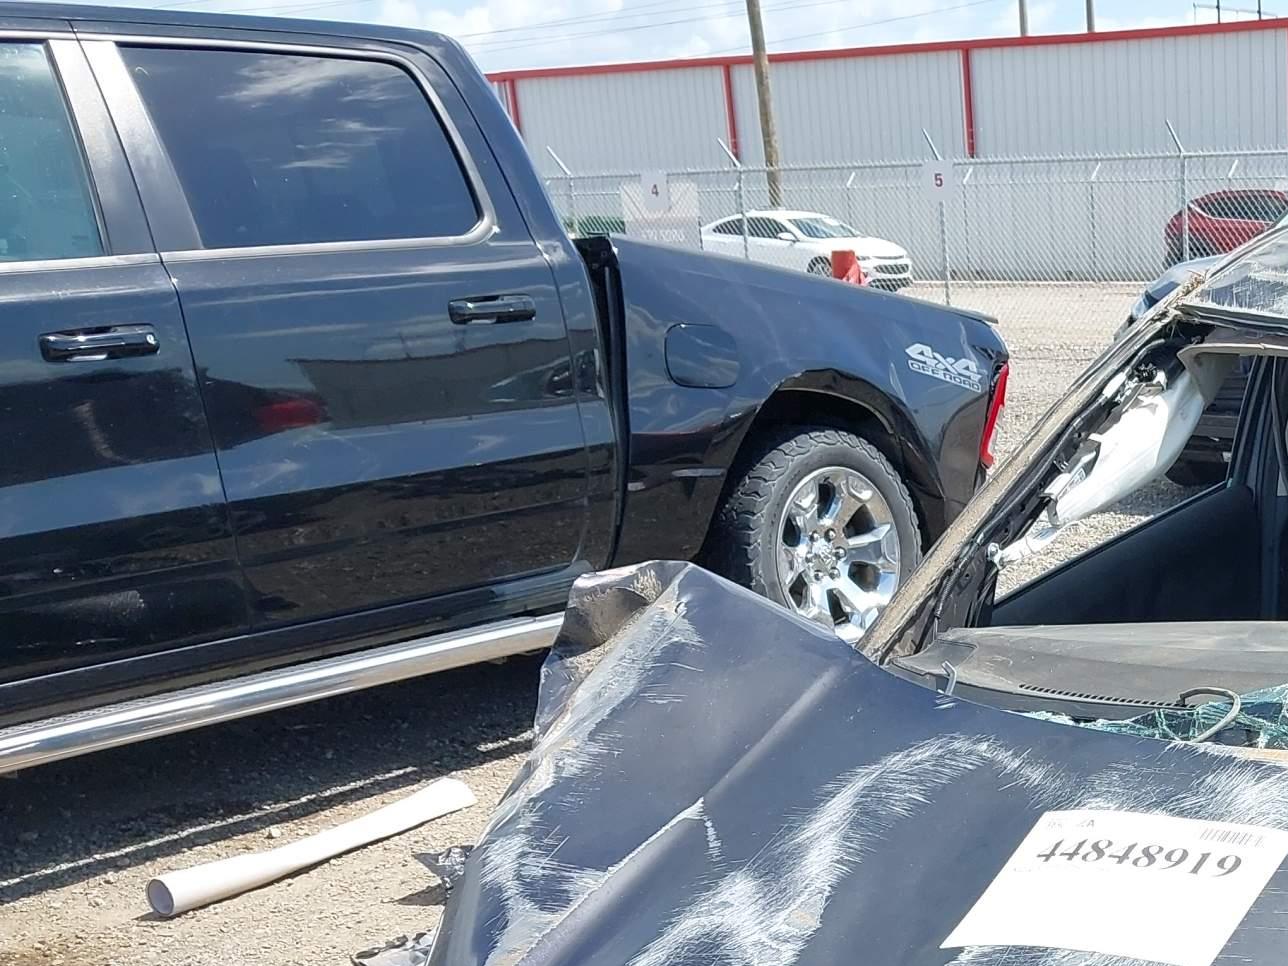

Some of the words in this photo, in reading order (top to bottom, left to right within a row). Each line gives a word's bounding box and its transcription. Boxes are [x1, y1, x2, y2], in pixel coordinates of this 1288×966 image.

[651, 184, 659, 196] 4
[934, 172, 944, 188] 5
[909, 361, 940, 376] OFF
[942, 371, 981, 392] ROAD
[1035, 838, 1242, 878] 44848919
